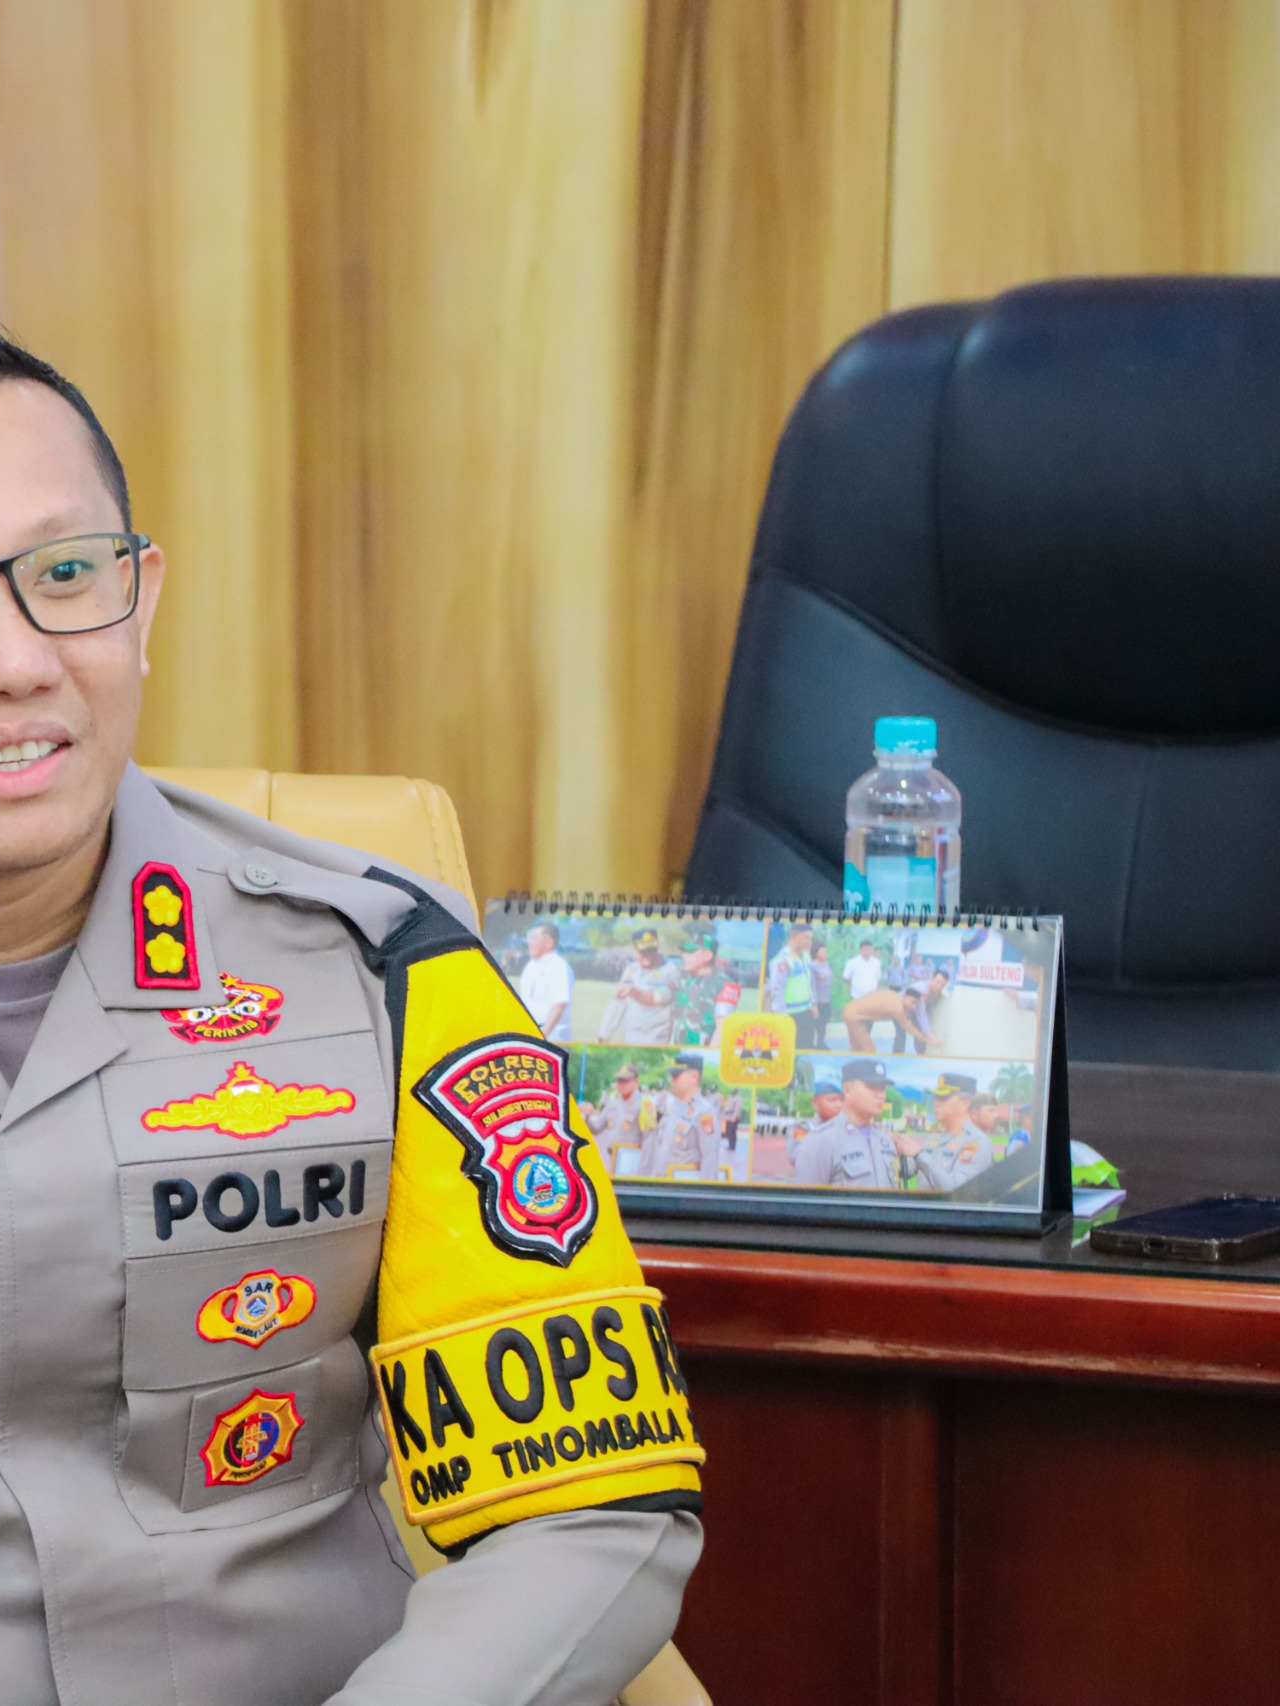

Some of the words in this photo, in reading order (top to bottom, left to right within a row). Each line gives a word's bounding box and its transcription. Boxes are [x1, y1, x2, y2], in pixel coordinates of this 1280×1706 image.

[194, 1019, 258, 1038] PERINTIS
[453, 1054, 549, 1095] POLRES
[152, 1159, 366, 1241] POLRI
[244, 1281, 273, 1296] SAR
[380, 1347, 475, 1460] KA
[485, 1305, 638, 1424] OPS
[410, 1455, 471, 1505] OMP
[492, 1408, 685, 1479] TINOMBALA
